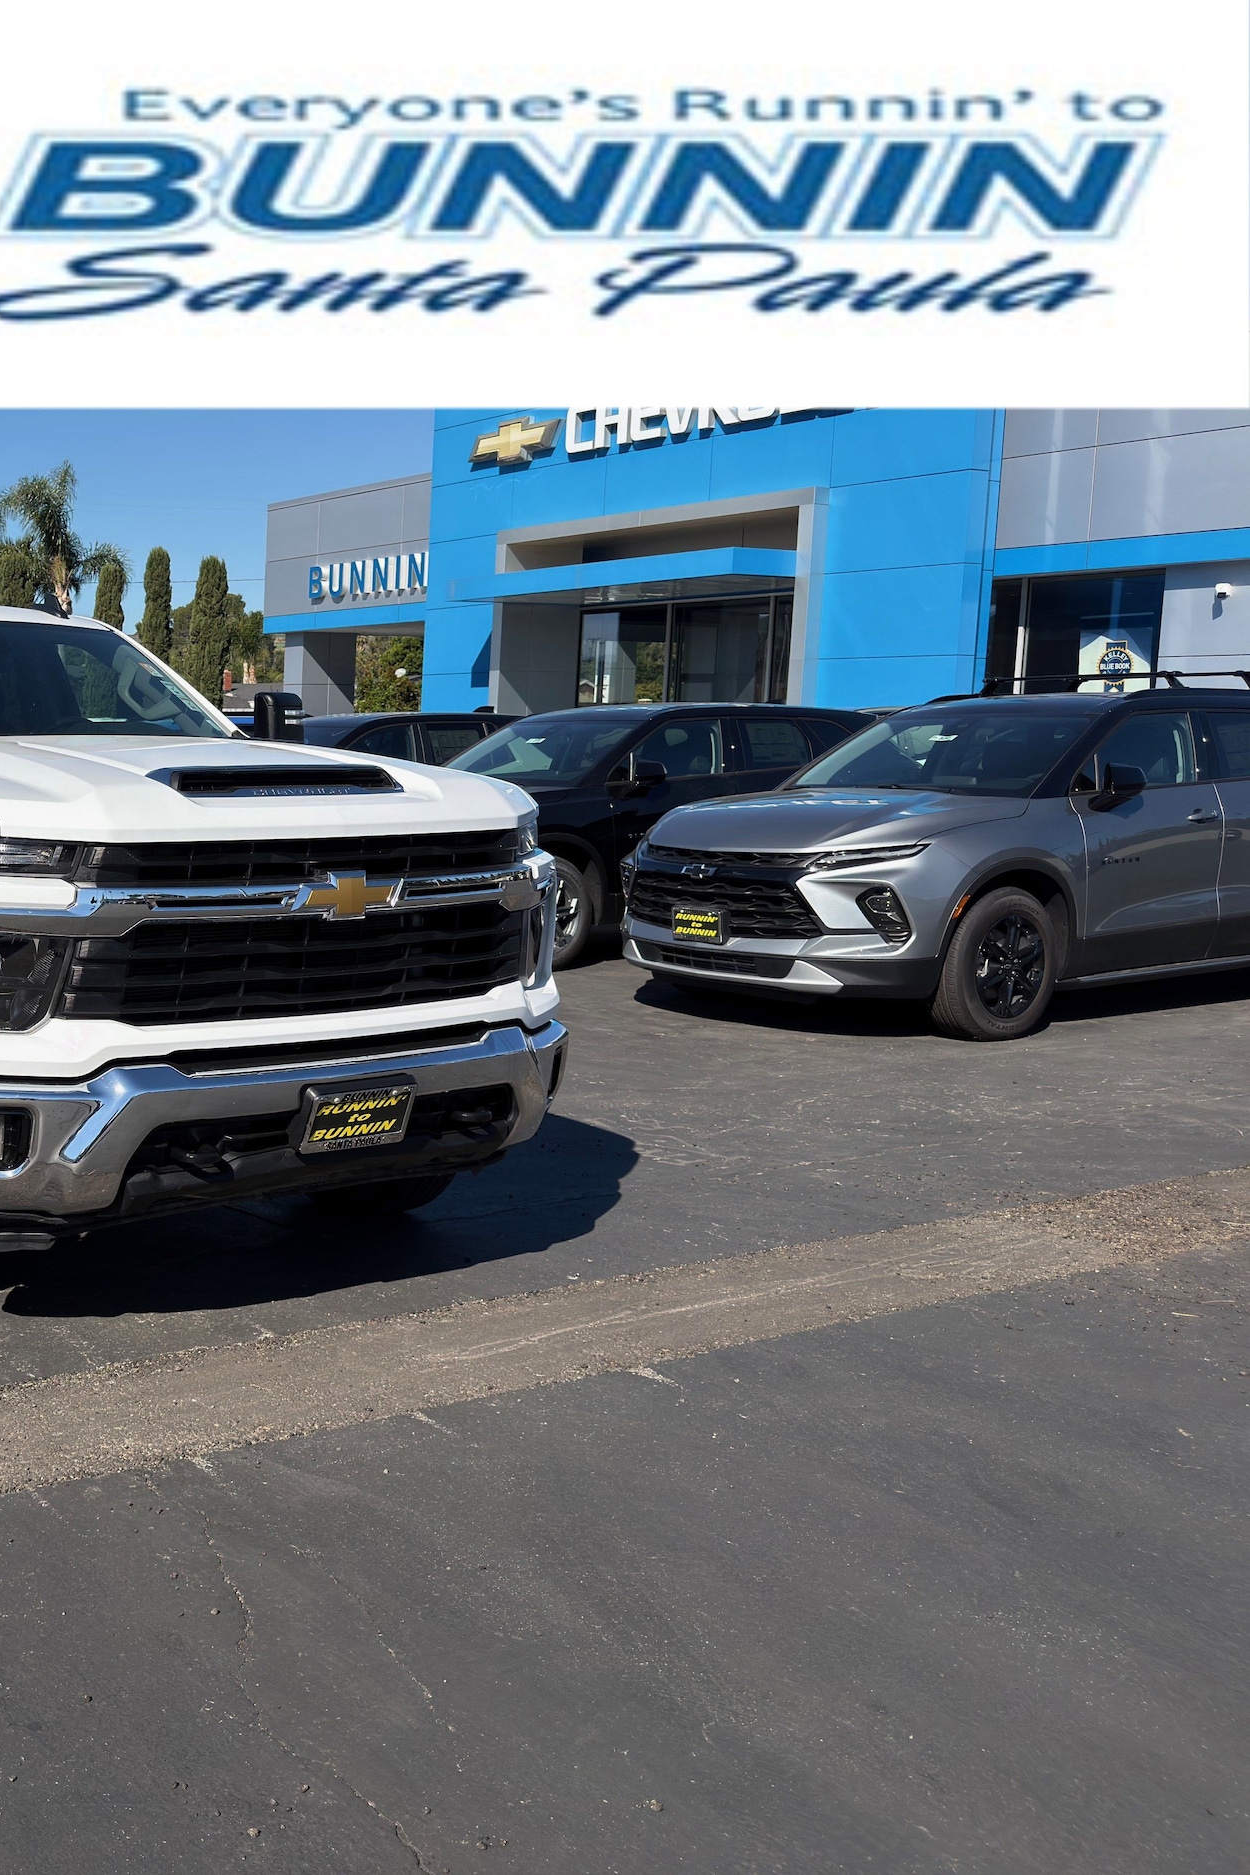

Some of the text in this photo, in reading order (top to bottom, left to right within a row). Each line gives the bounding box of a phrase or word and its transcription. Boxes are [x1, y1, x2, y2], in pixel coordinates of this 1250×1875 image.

[308, 551, 430, 599] BUNNIN
[1103, 650, 1129, 662] KELLEY
[1099, 662, 1130, 670] BLUE BOOK
[675, 926, 718, 937] BUNNIN
[347, 1112, 372, 1123] to
[308, 1118, 398, 1142] BUNNIN
